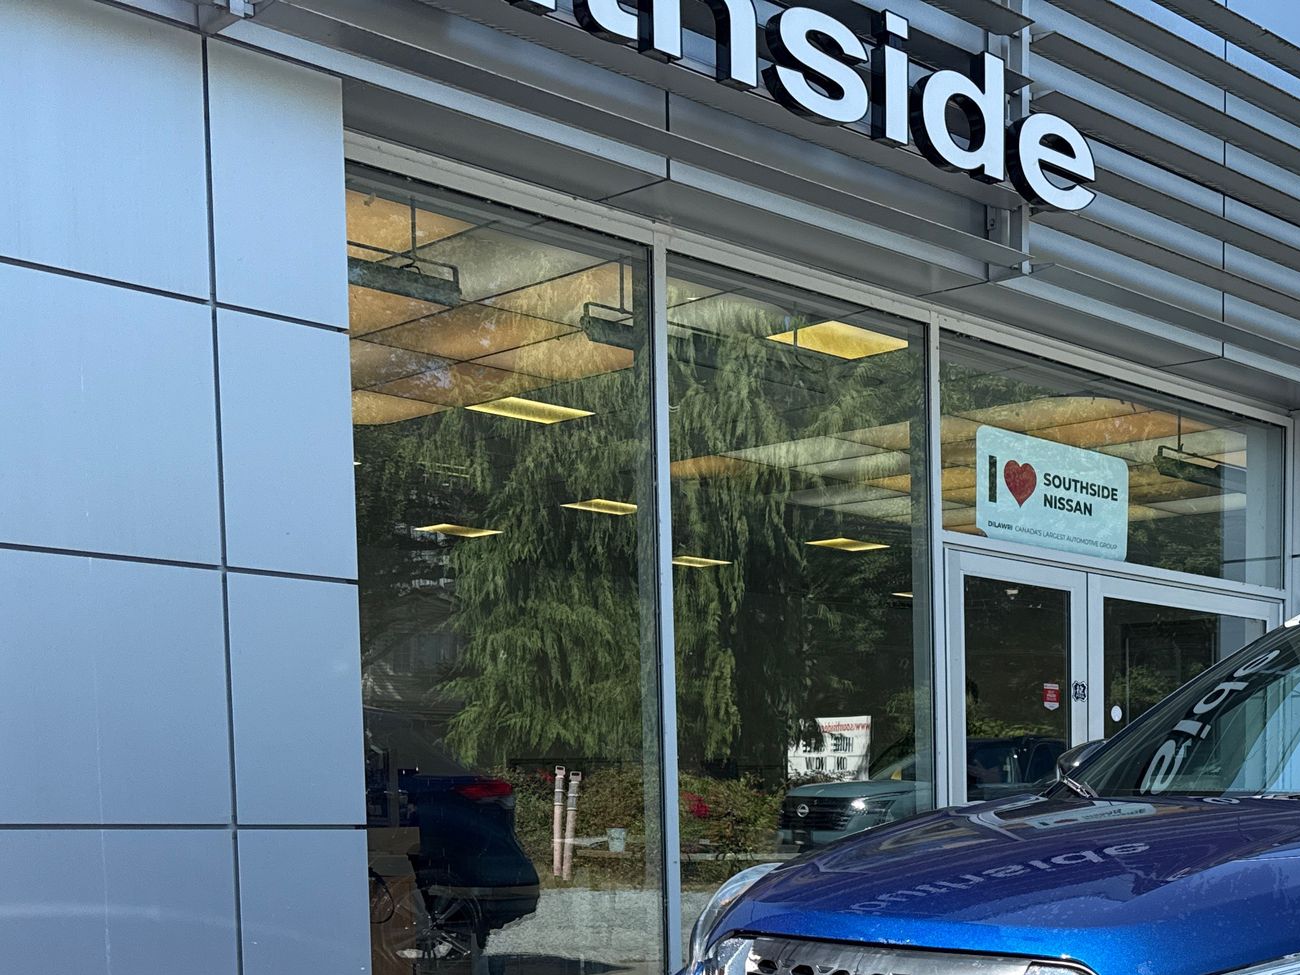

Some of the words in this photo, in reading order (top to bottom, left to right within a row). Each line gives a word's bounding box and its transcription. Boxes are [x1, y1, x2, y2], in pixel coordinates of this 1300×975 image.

[988, 454, 997, 503] I
[1043, 472, 1118, 502] SOUTHSIDE
[1043, 493, 1093, 517] NISSAN
[987, 520, 1013, 531] DILAWRI
[1043, 531, 1066, 541] LARGEST
[1066, 535, 1099, 548] AUTOMOTIVE
[1099, 541, 1118, 551] GROUP
